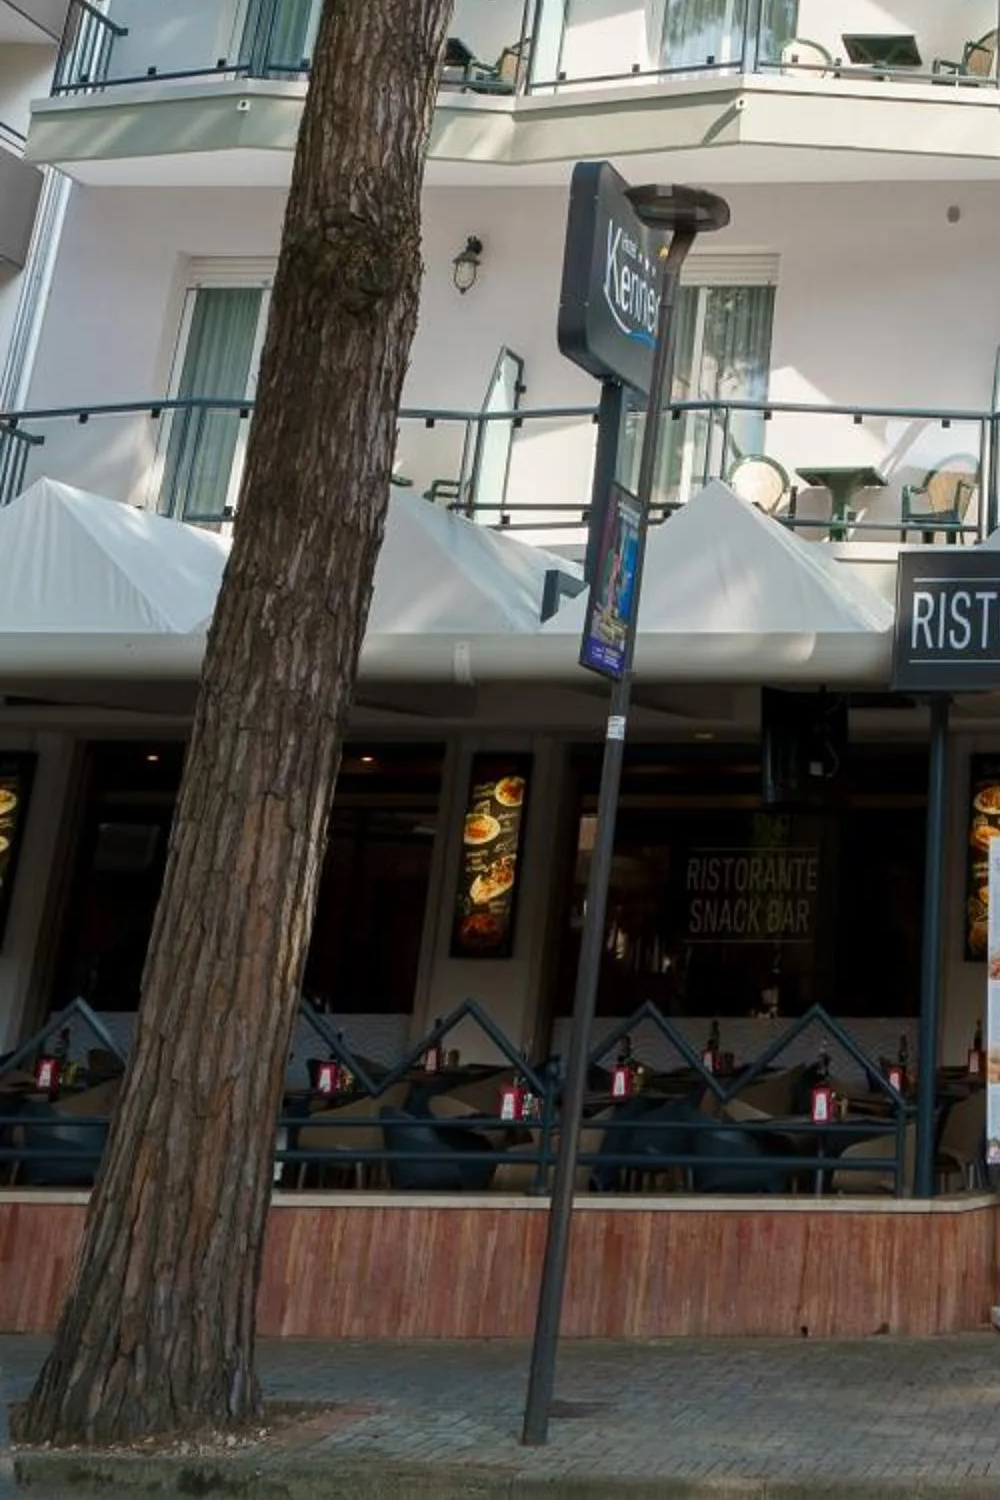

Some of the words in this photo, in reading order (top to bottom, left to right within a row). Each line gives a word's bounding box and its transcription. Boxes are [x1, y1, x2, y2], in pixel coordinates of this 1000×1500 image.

[605, 219, 661, 333] Kenne
[686, 857, 817, 891] RISTORANTE
[689, 899, 760, 933] SNACK
[767, 899, 809, 933] BAR
